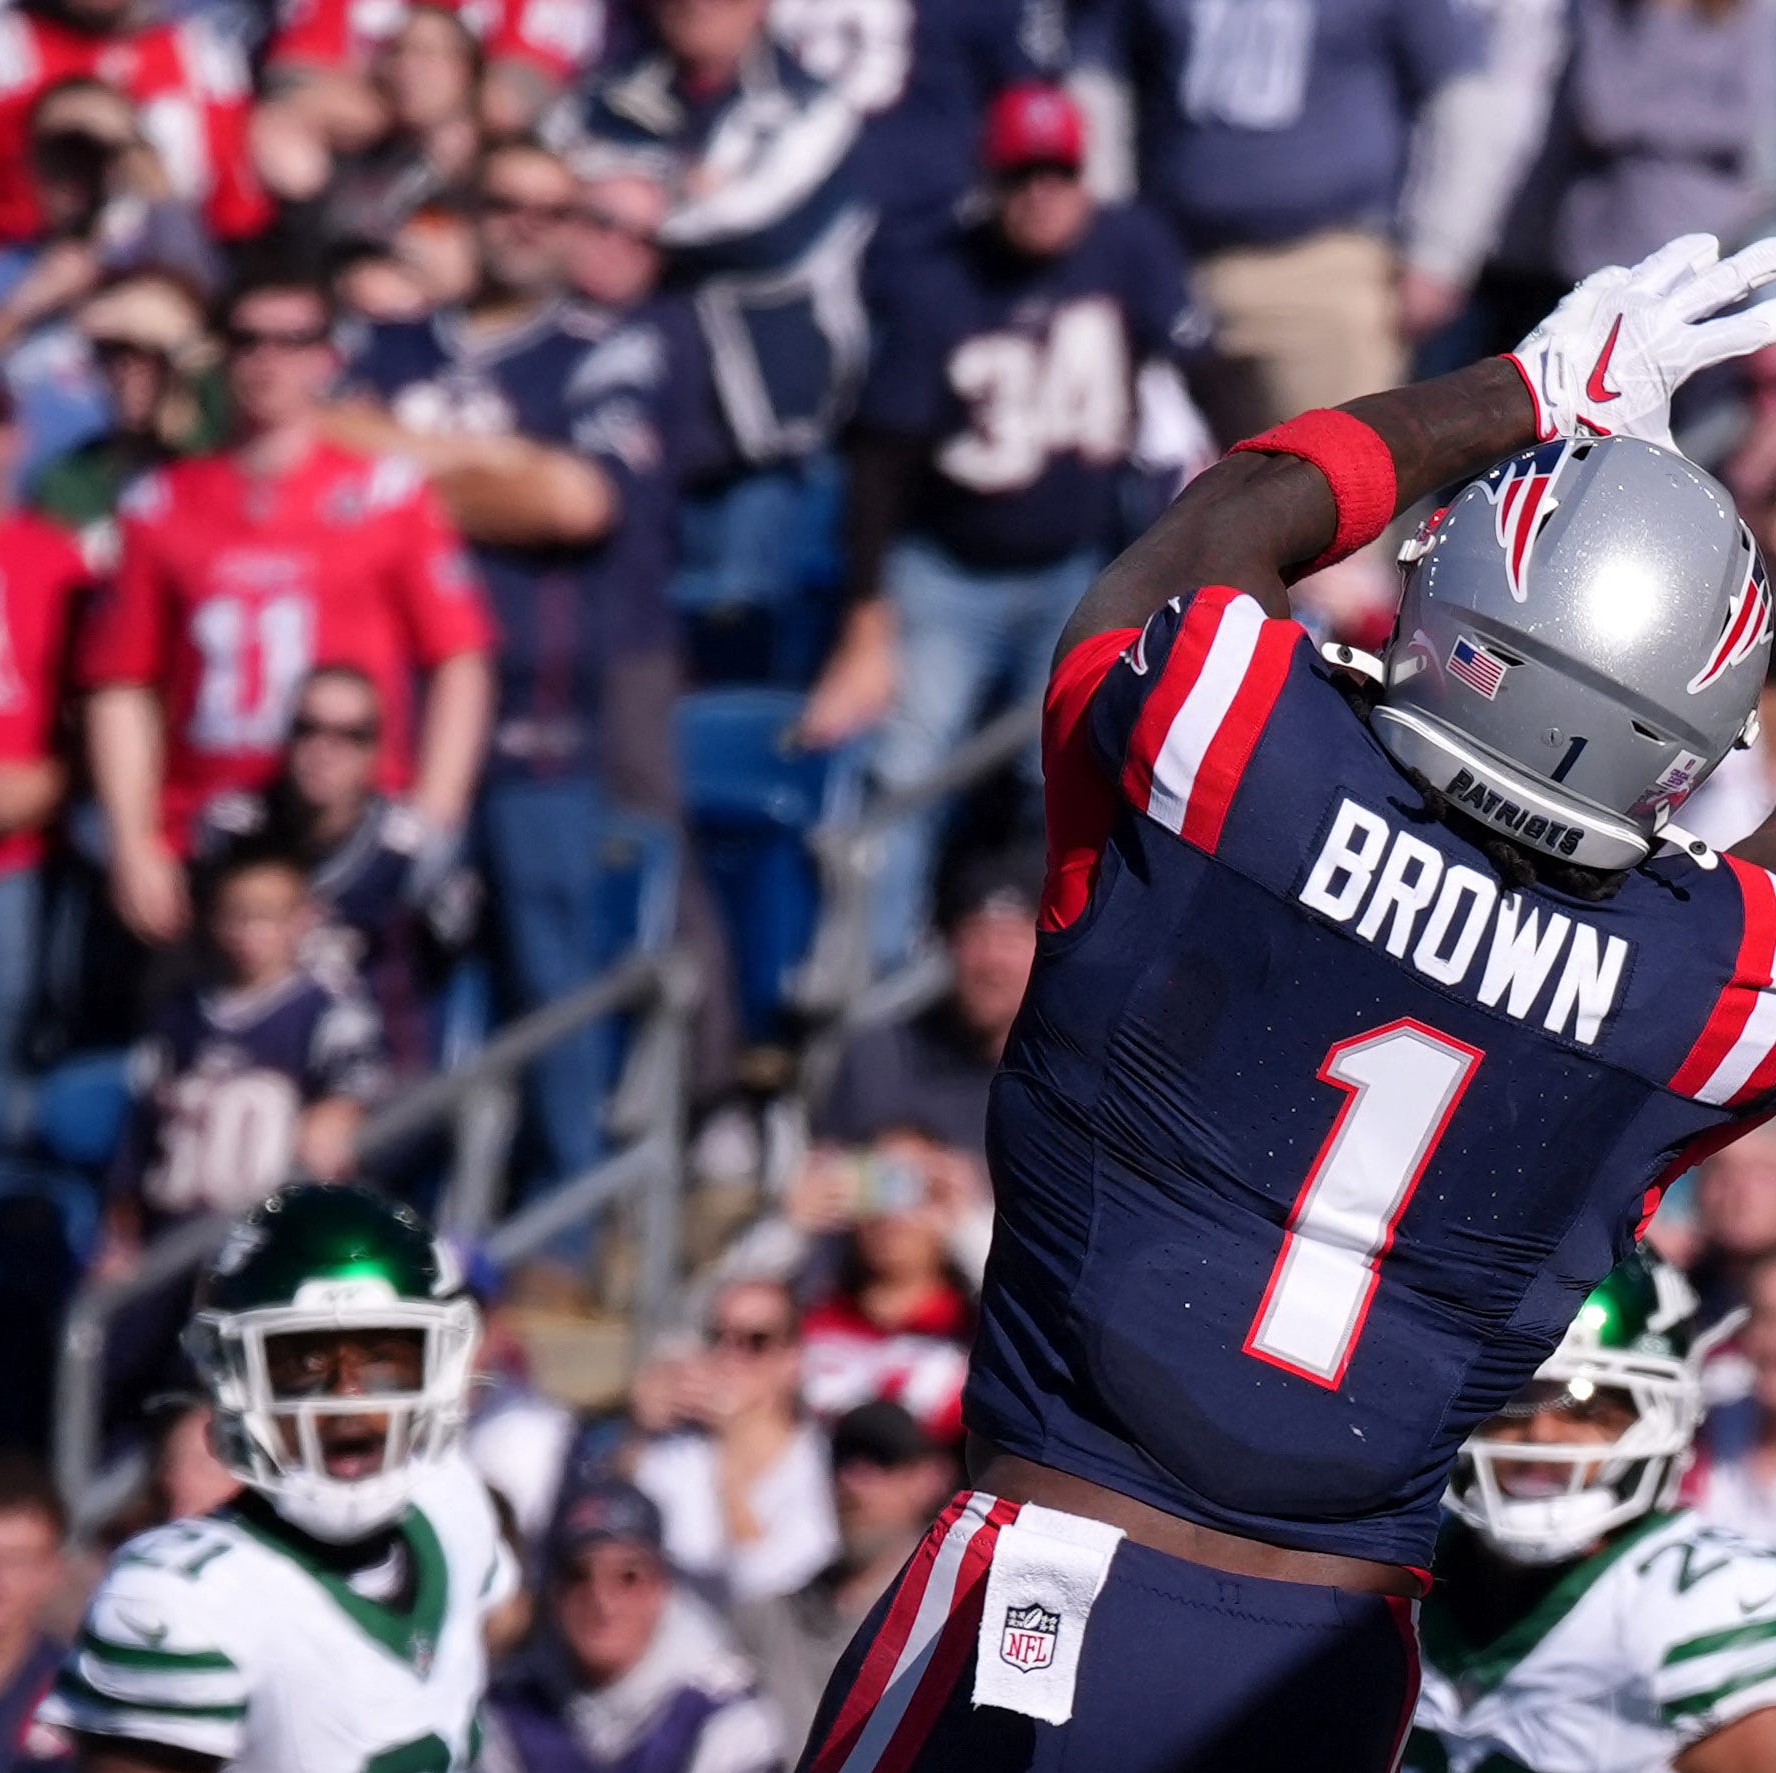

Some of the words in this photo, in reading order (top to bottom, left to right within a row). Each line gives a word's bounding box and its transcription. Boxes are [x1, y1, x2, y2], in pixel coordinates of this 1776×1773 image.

[936, 296, 1125, 493] 34
[1445, 767, 1585, 857] PATRIOTS
[1550, 736, 1588, 783] 1
[1298, 797, 1629, 1046] BROWN
[1240, 1016, 1487, 1392] 1
[1006, 1631, 1047, 1664] NFL
